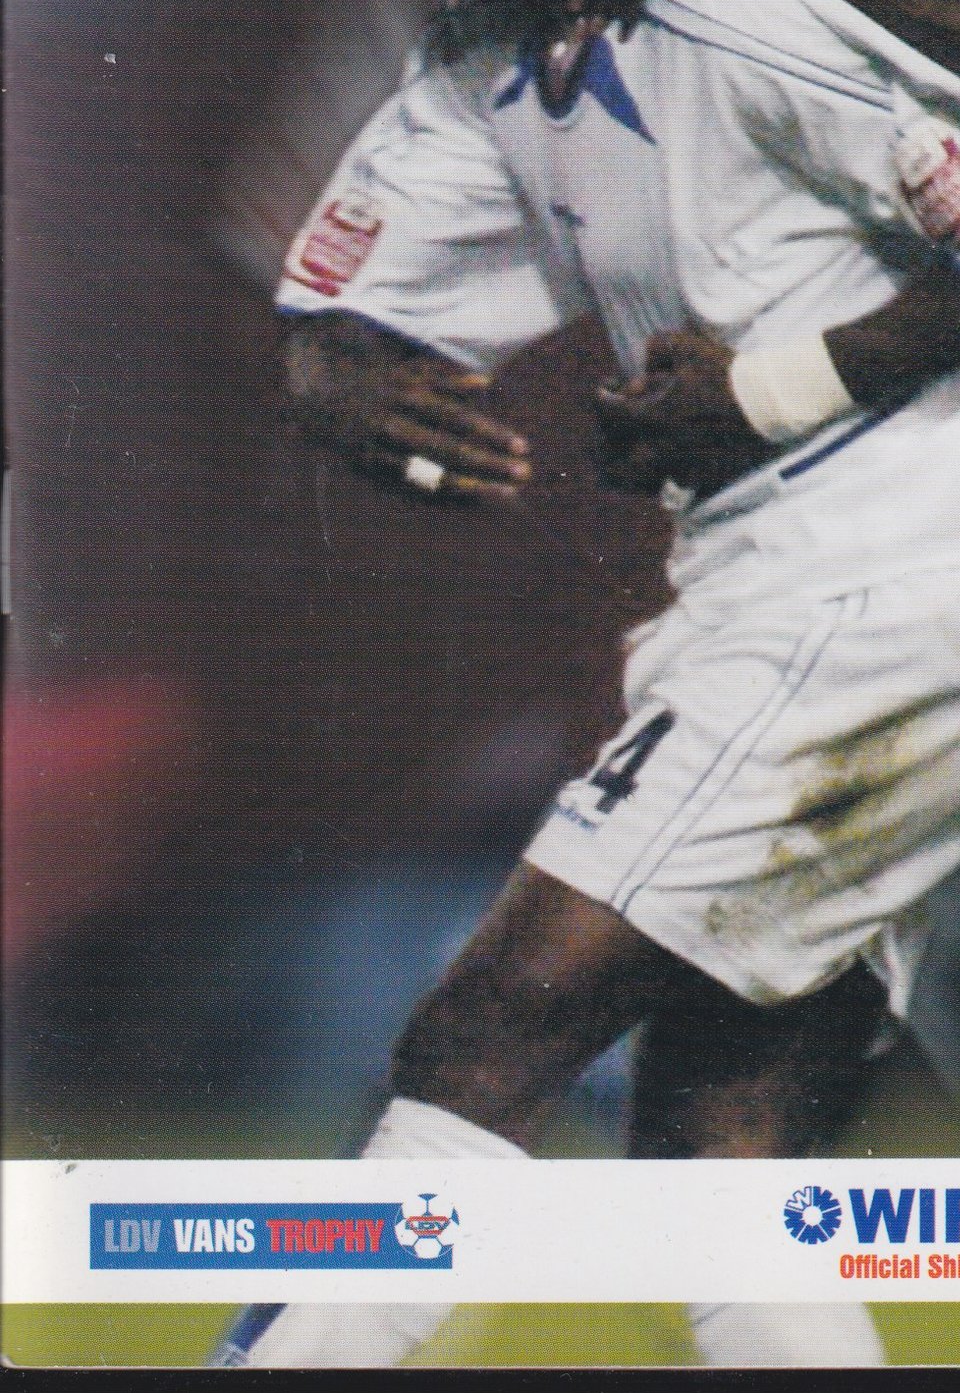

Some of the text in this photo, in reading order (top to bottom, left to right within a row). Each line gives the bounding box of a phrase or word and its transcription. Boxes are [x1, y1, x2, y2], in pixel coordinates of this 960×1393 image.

[589, 708, 680, 815] 4
[105, 1219, 386, 1254] LDV VANS TROPHY
[839, 1254, 921, 1280] Official
